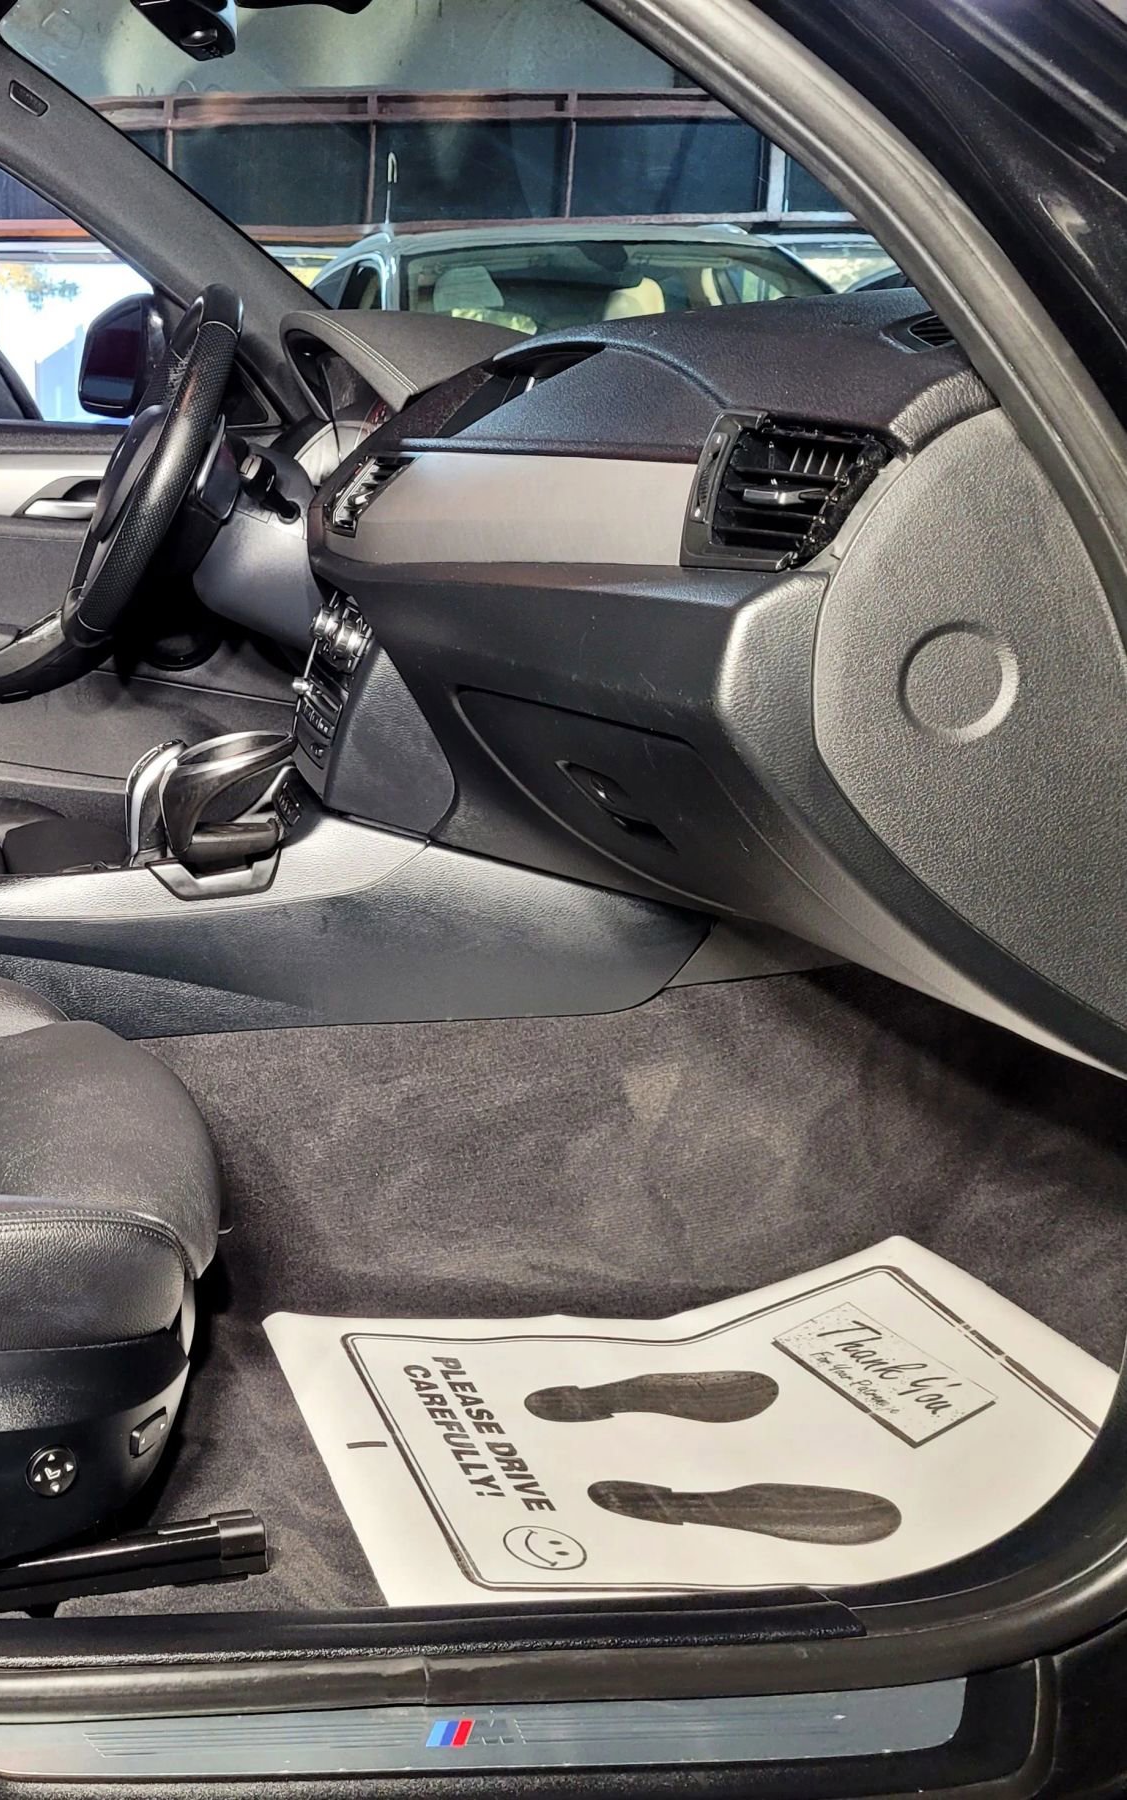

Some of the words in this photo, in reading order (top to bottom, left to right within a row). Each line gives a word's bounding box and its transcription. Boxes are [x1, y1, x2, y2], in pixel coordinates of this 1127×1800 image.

[403, 1364, 506, 1498] CAREFULLY!
[431, 1356, 506, 1435] PLEASE
[485, 1441, 557, 1512] DRIVE
[817, 1320, 928, 1380] Thank
[898, 1376, 963, 1415] You
